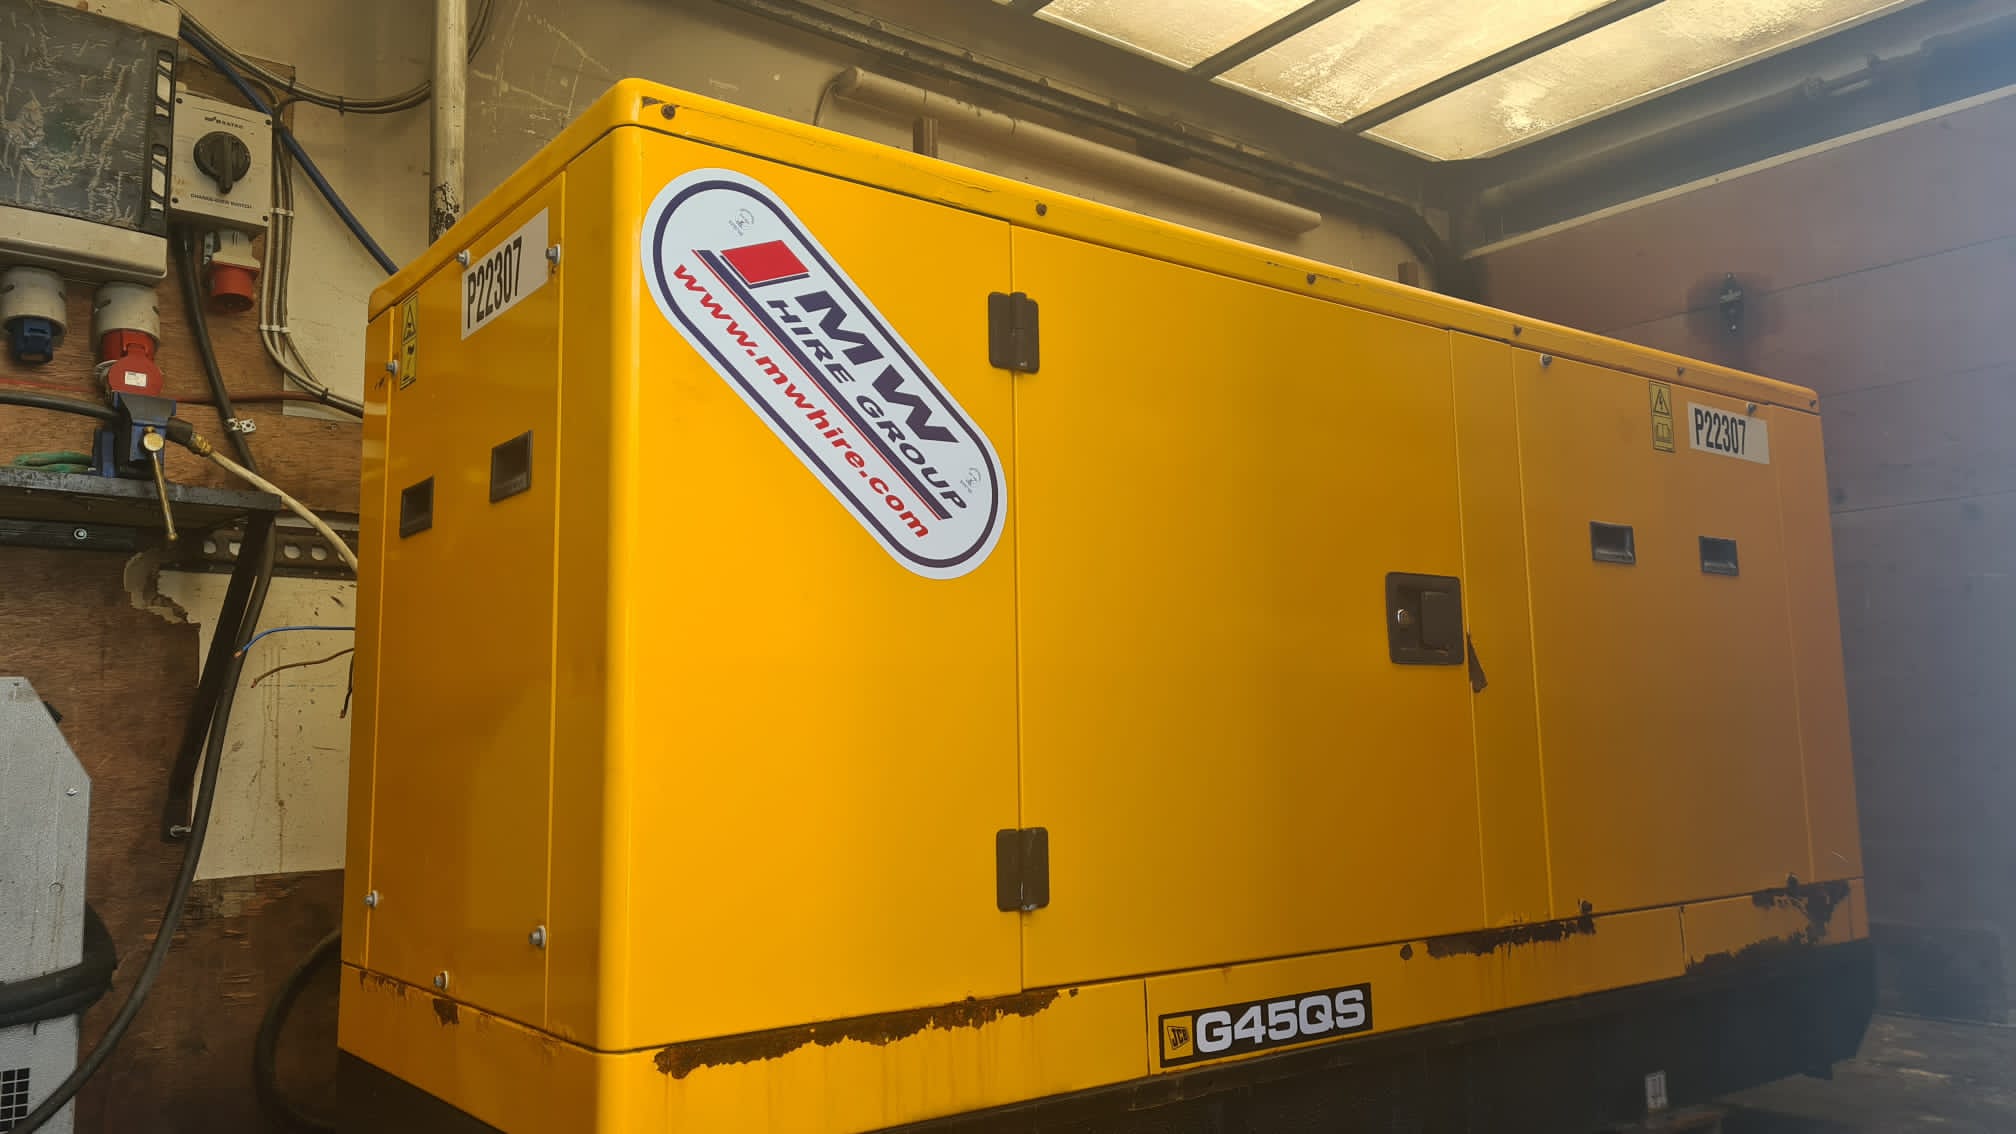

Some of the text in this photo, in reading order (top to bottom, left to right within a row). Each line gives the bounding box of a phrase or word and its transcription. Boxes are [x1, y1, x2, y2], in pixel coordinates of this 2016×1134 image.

[467, 235, 523, 329] P22307
[673, 264, 929, 539] www.mwhire.com
[766, 300, 968, 509] HIRE GROUP
[795, 290, 960, 444] MW
[1694, 407, 1746, 455] P22307
[1169, 1027, 1189, 1048] JCB
[1196, 989, 1366, 1053] G45QS
